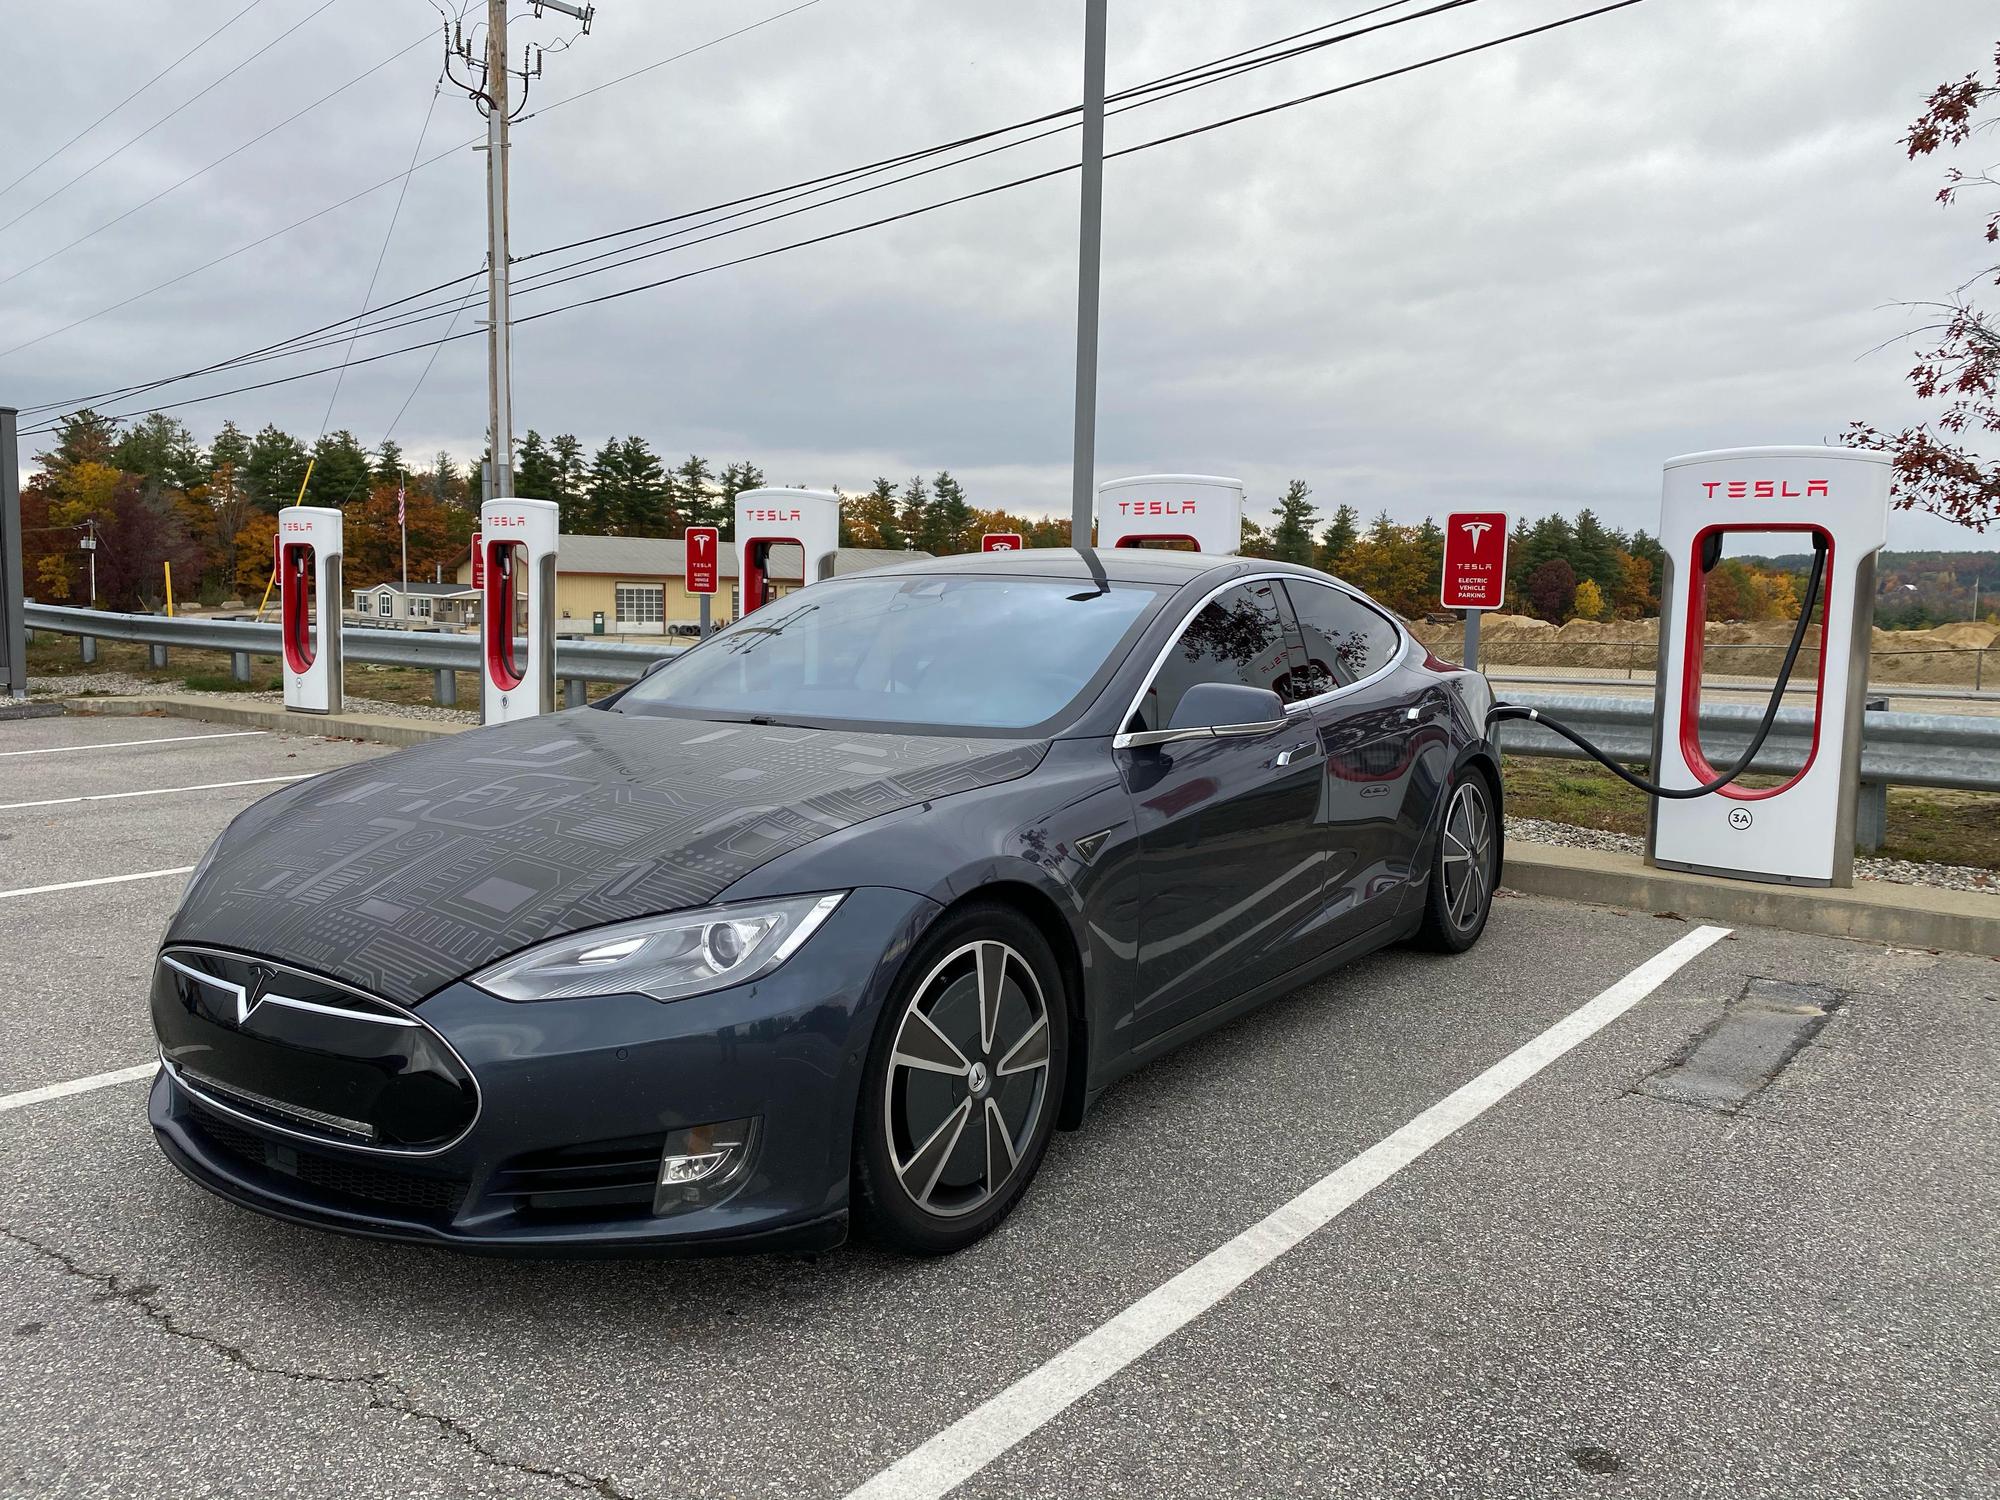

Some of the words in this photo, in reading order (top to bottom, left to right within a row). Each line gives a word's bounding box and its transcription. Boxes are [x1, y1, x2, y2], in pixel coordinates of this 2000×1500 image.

[1702, 481, 1829, 499] TESLA
[1119, 501, 1195, 516] TESLA
[488, 516, 525, 526] TESLA
[746, 510, 801, 521] TESLA
[283, 523, 312, 531] TESLA
[1732, 813, 1749, 824] 3A
